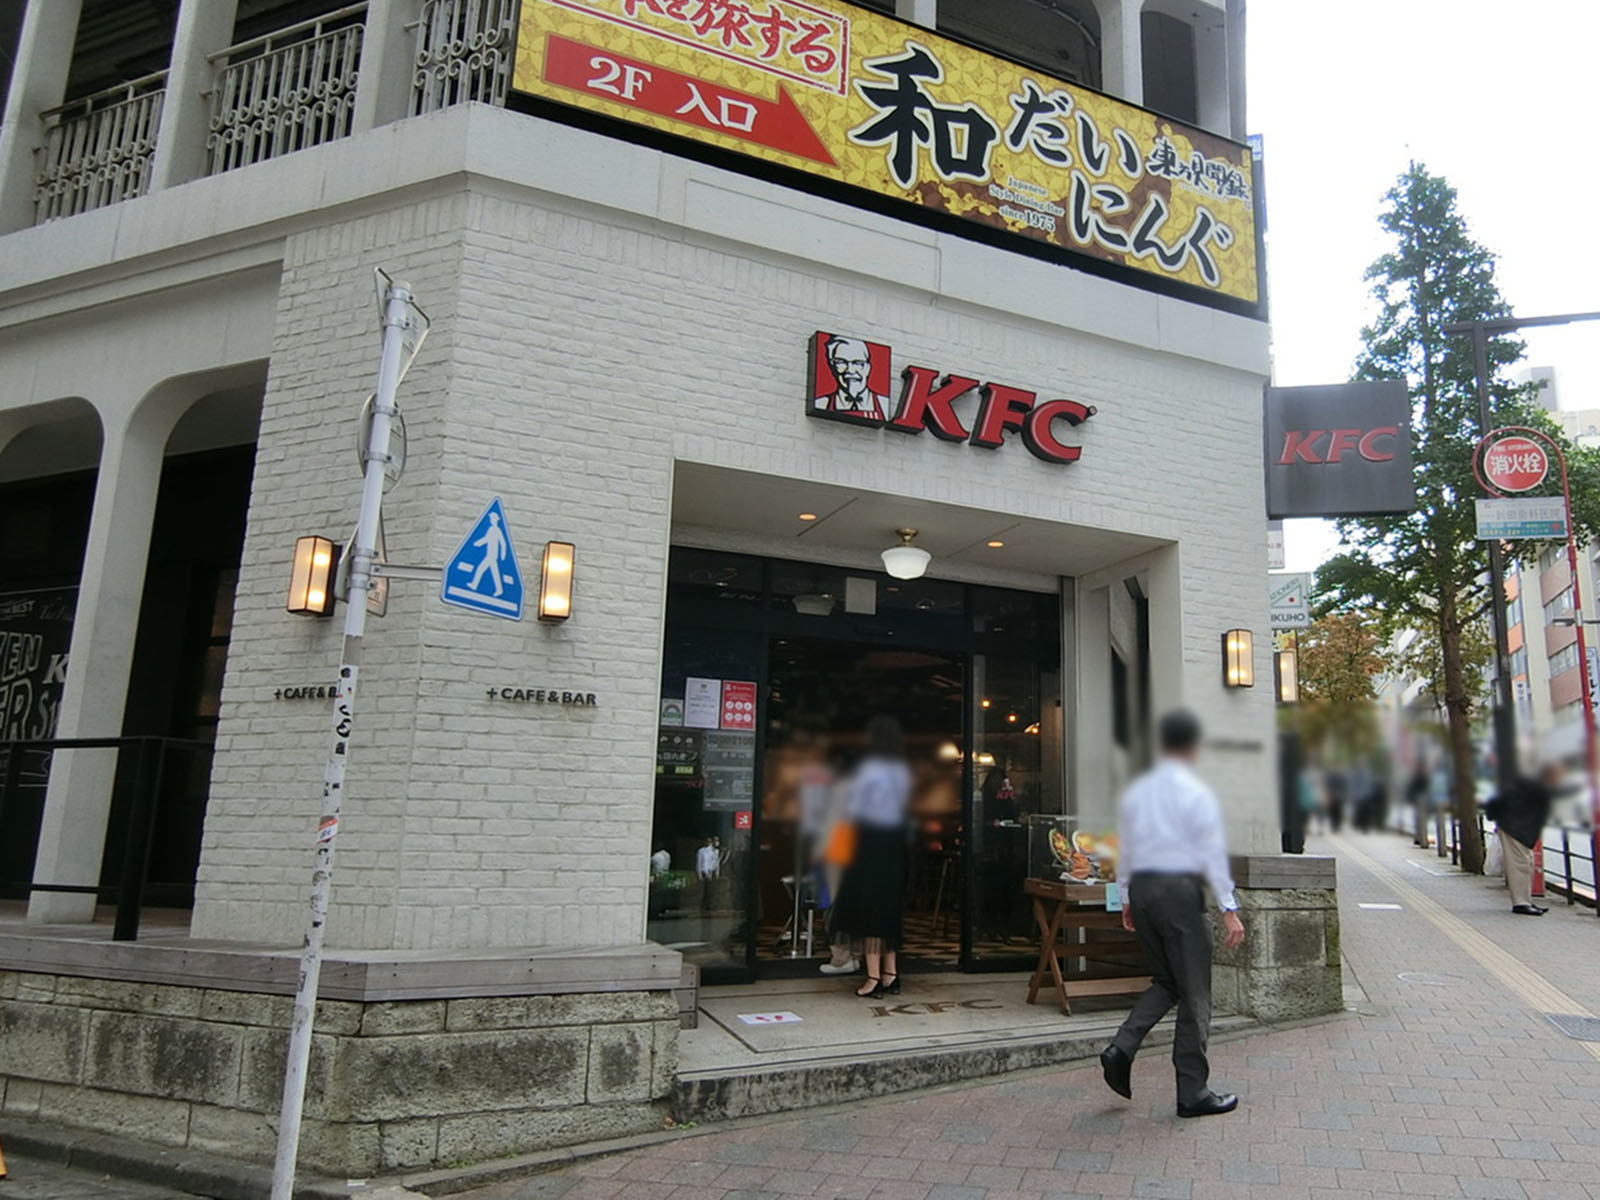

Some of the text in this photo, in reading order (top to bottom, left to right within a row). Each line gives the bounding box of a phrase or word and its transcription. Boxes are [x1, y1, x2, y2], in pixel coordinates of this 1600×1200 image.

[587, 57, 758, 132] 2F 入口
[1025, 210, 1056, 232] 1975
[886, 365, 1090, 464] KFC
[1275, 426, 1398, 465] KFC
[1490, 452, 1542, 475] 消火栓
[1270, 612, 1305, 622] IKUHO
[868, 998, 1004, 1018] KFC
